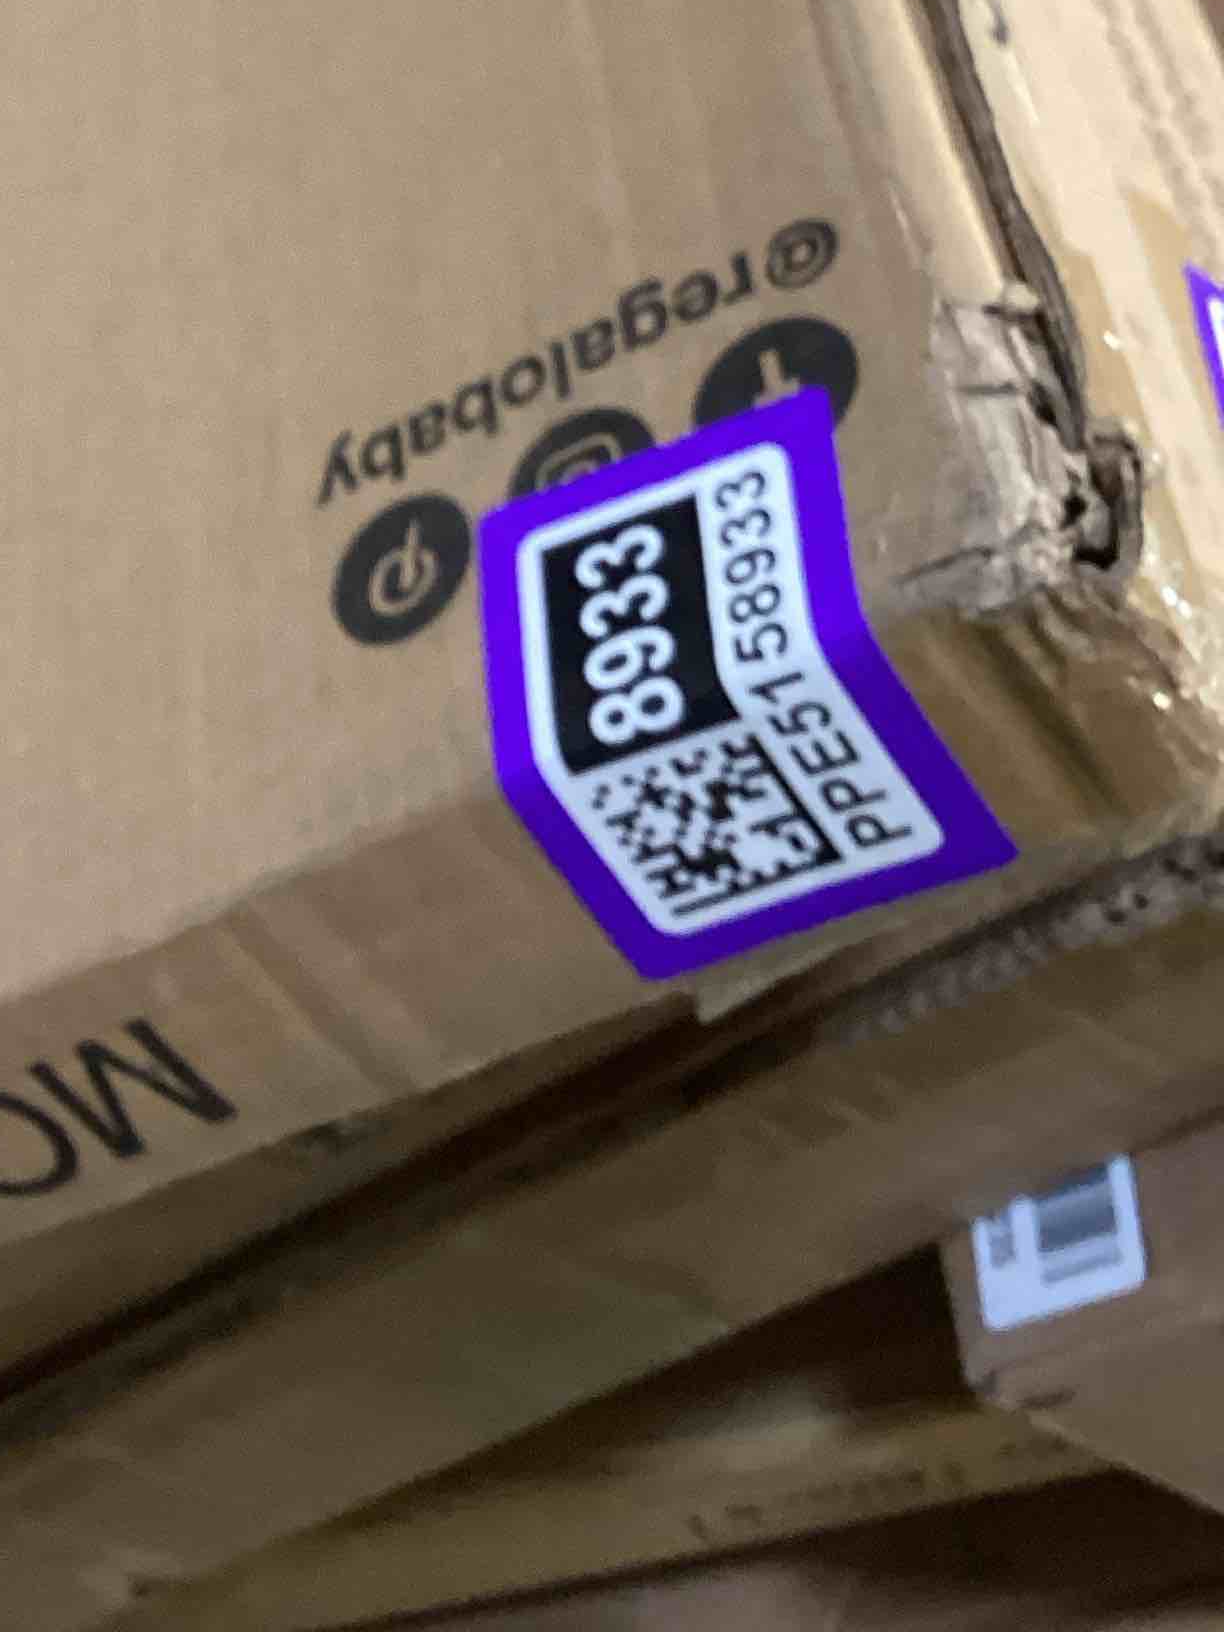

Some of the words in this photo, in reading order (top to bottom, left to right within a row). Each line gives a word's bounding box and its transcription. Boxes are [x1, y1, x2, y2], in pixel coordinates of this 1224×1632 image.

[316, 217, 842, 508] @regalobaby
[573, 520, 686, 752] 8933
[714, 470, 914, 854] PPE5158933
